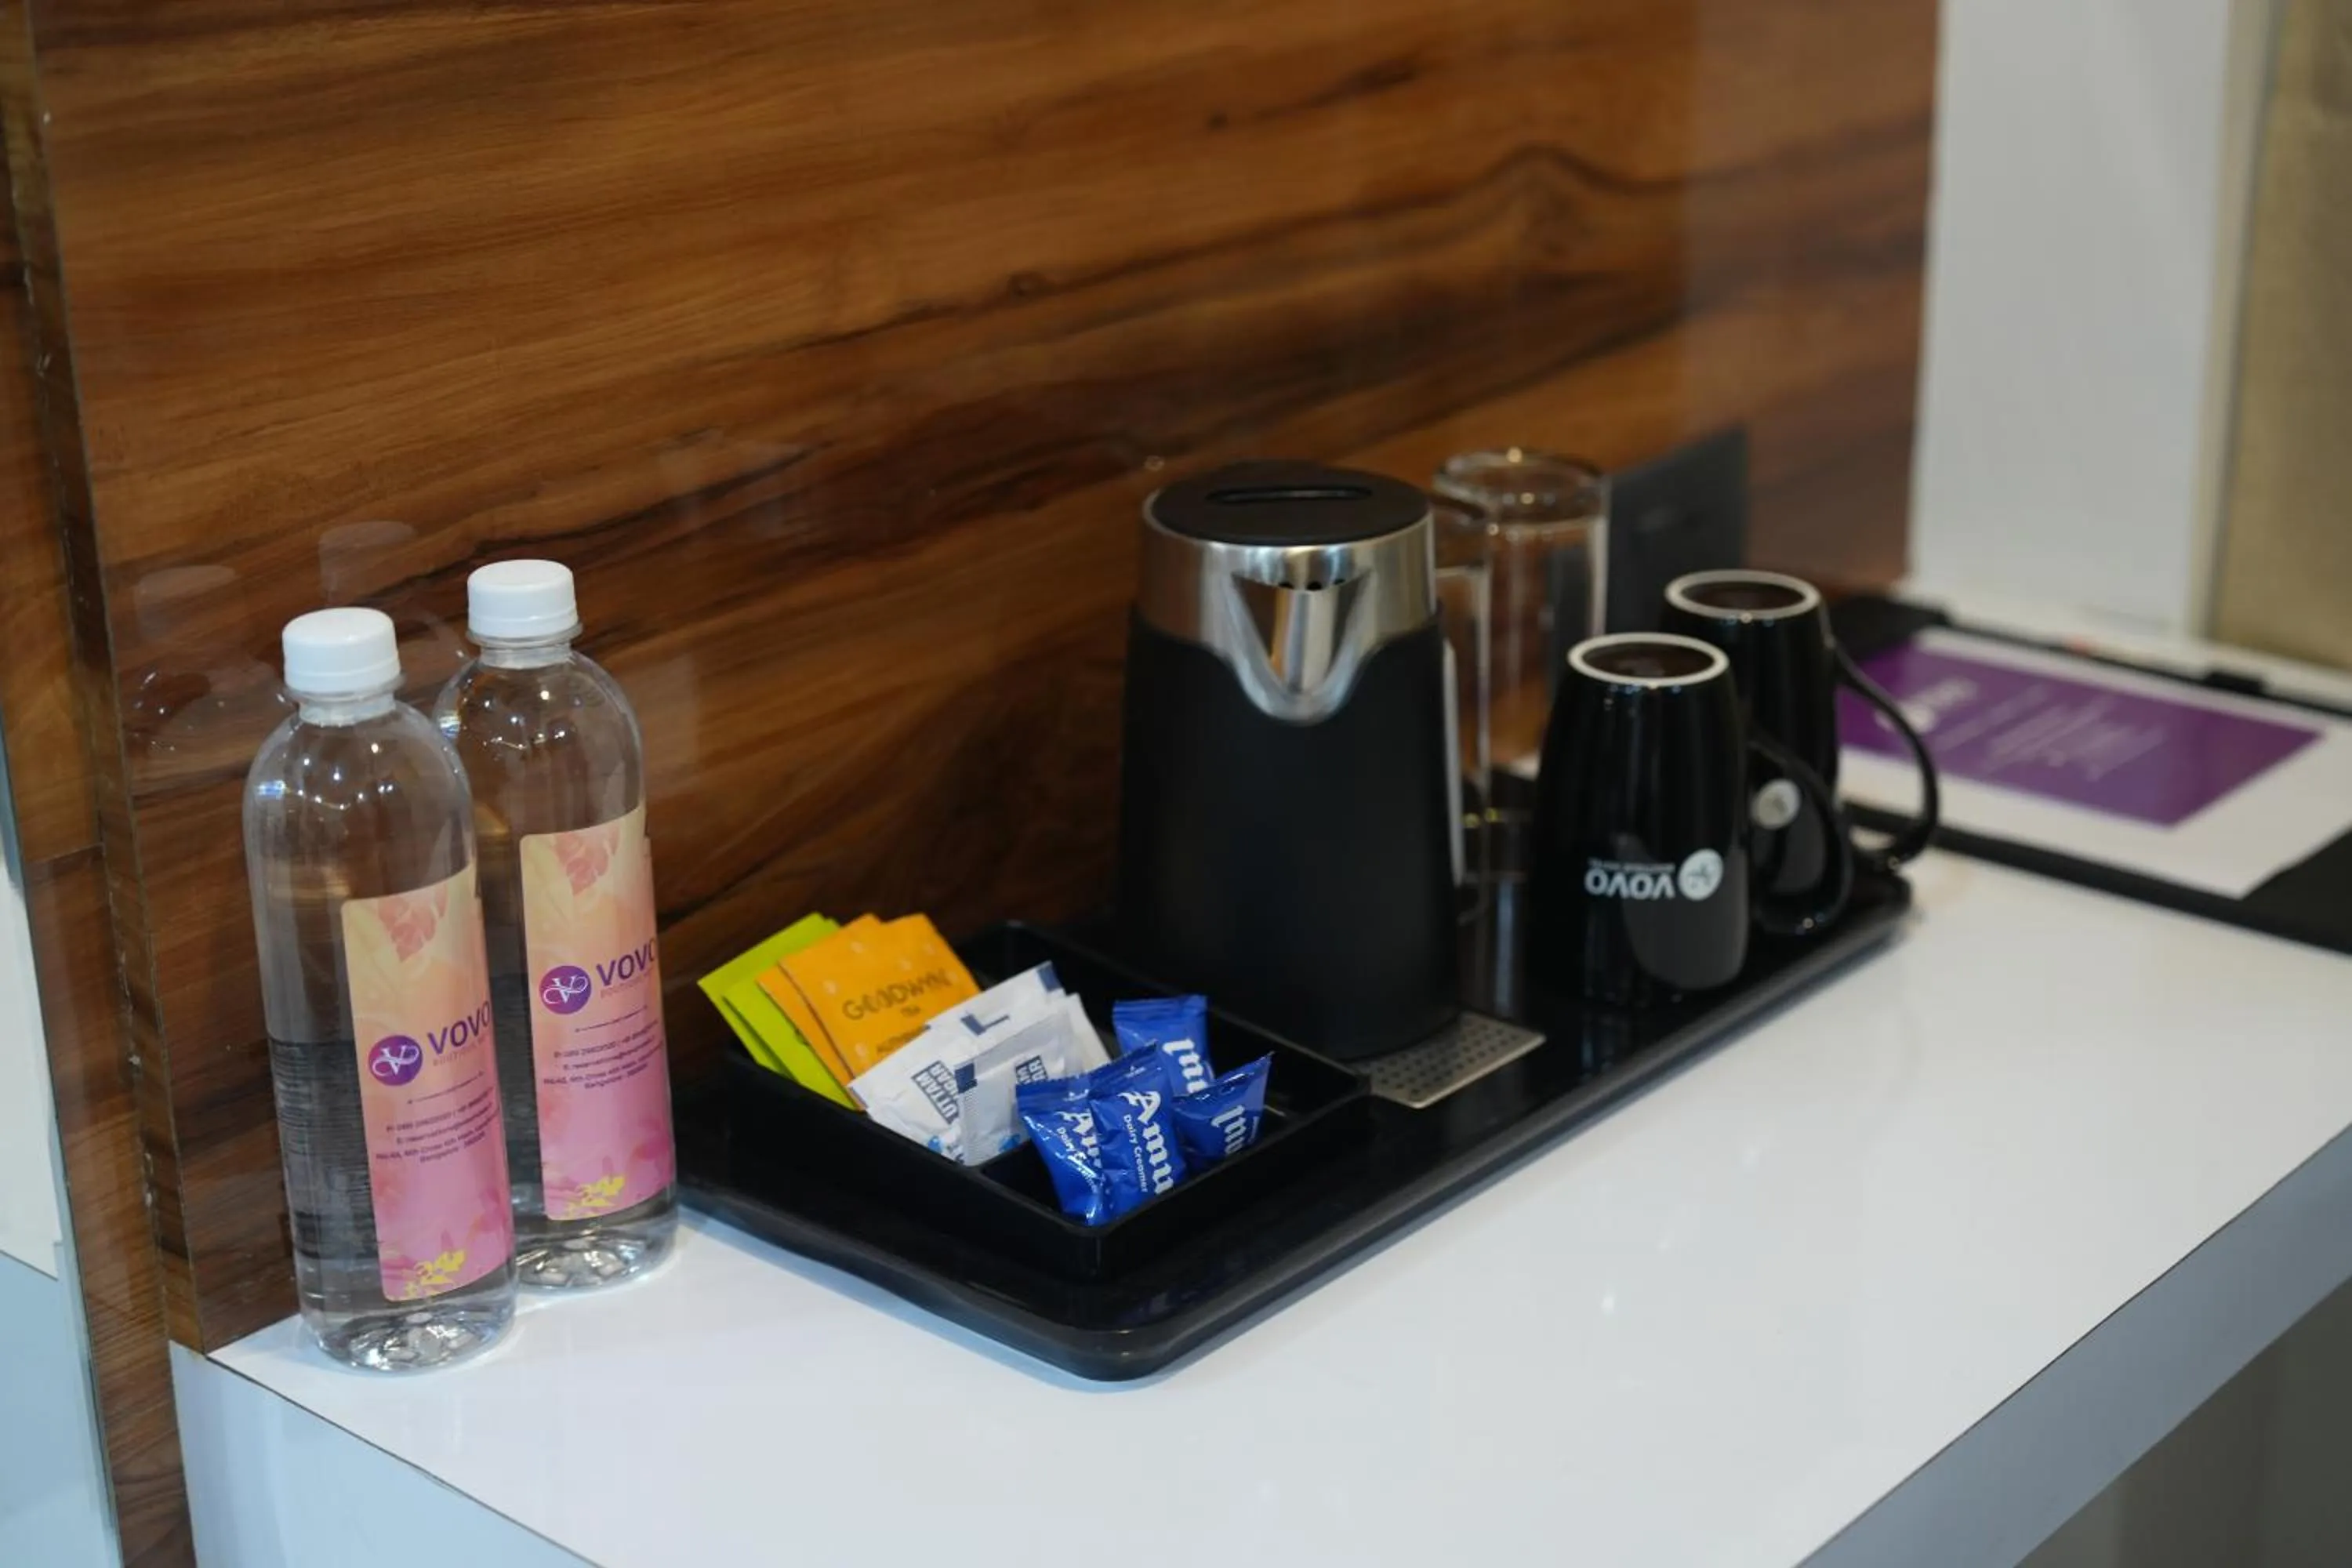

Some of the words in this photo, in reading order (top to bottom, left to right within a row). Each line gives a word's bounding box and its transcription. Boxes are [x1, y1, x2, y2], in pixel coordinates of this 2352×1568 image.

[1584, 868, 1676, 900] VOVO
[427, 1000, 490, 1054] VOVO
[916, 1070, 957, 1119] UTTAM
[1116, 1091, 1174, 1194] Amu
[1123, 1113, 1138, 1145] Dairy
[1133, 1145, 1149, 1193] Creamer
